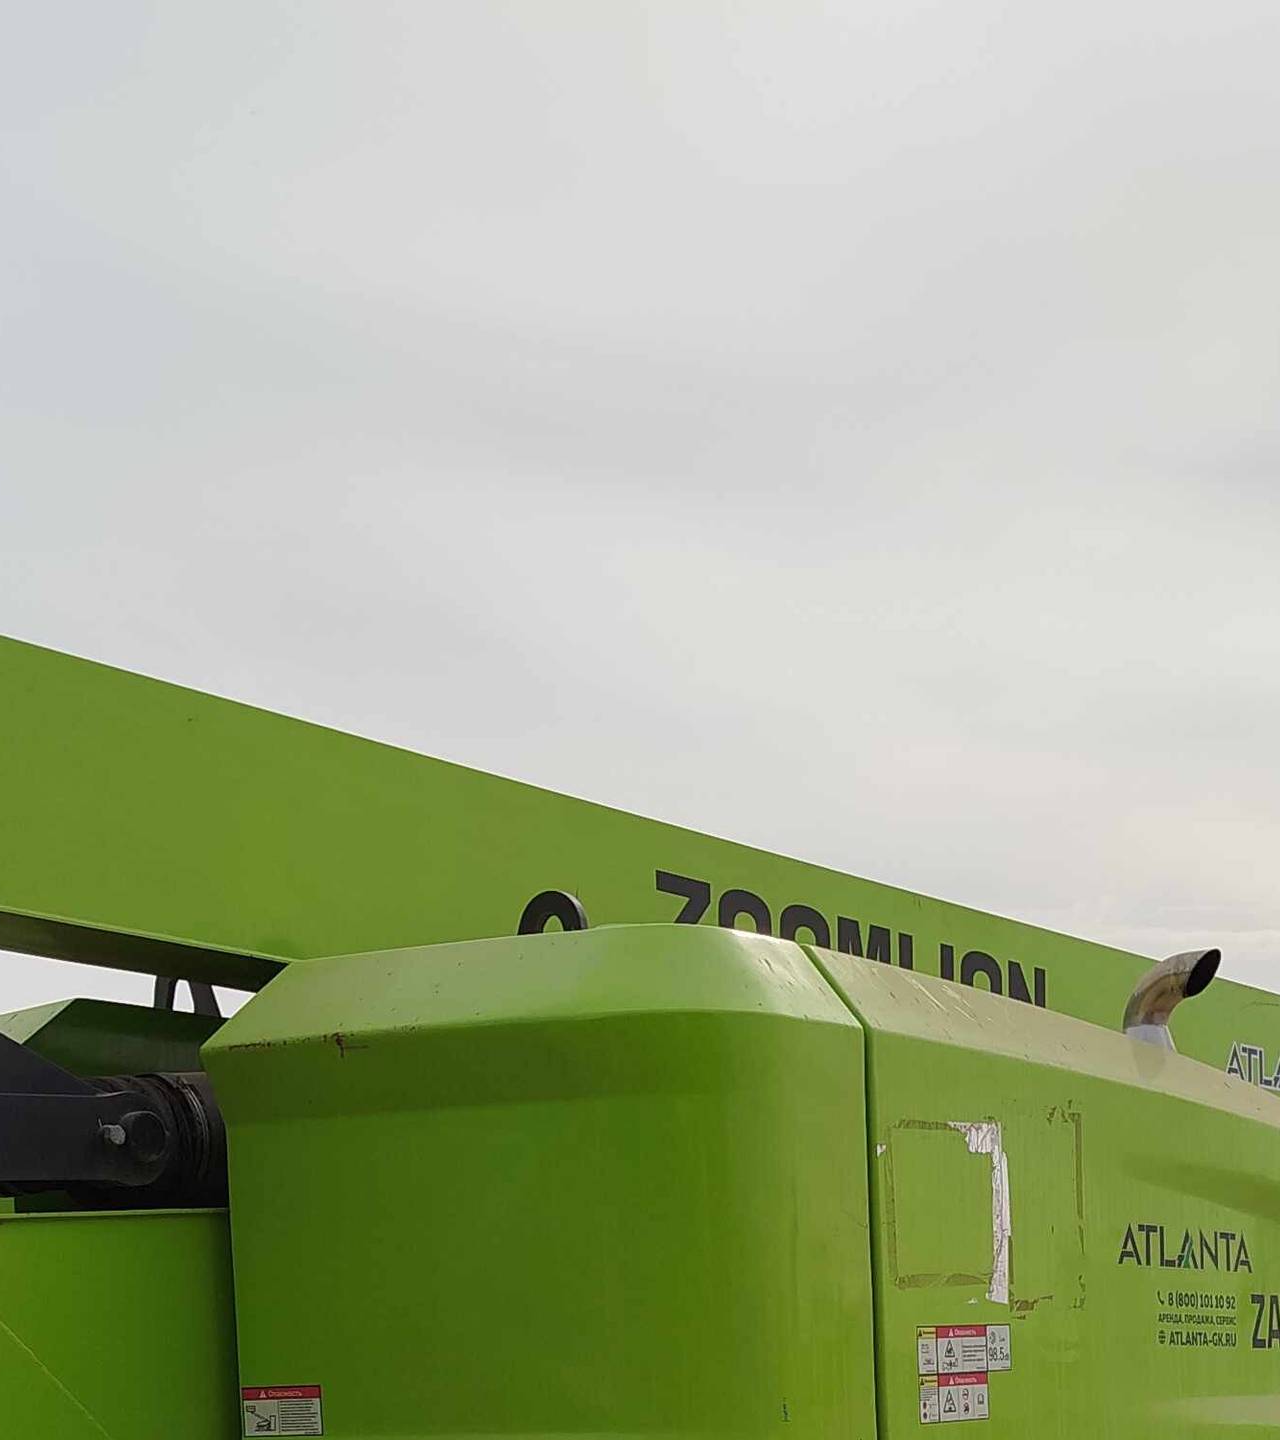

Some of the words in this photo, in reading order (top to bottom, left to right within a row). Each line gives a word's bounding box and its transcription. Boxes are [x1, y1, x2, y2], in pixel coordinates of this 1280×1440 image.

[1119, 1223, 1253, 1274] ATLANTA
[1168, 1292, 1174, 1306] 8
[1175, 1290, 1198, 1309] (800)
[1200, 1293, 1213, 1308] 101
[1215, 1294, 1224, 1309] 10
[1225, 1296, 1236, 1310] 92
[1169, 1331, 1237, 1347] ATLANTA-GK.RU
